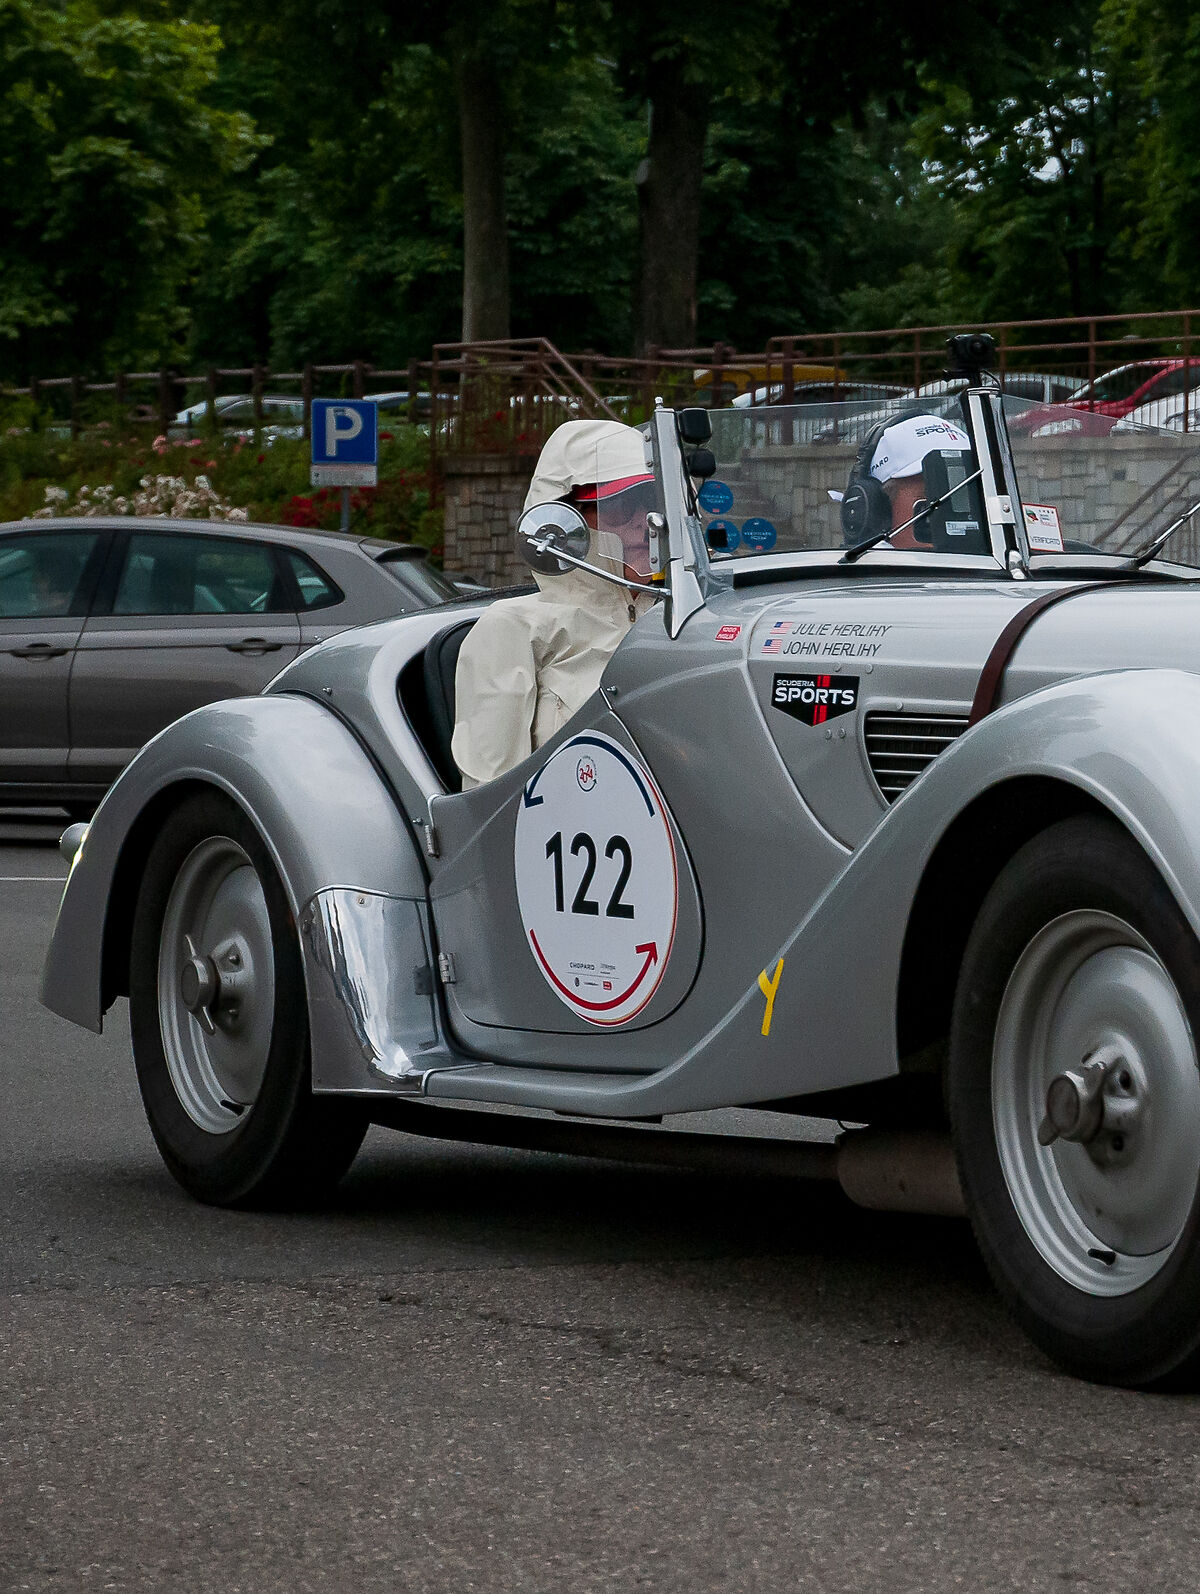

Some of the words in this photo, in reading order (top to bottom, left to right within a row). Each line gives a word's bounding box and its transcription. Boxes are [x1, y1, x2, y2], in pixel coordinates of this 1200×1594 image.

[326, 406, 363, 457] P
[871, 456, 889, 472] PARD
[792, 623, 831, 636] JULIE
[830, 624, 893, 637] HERLIHY
[782, 641, 821, 655] JOHN
[821, 642, 882, 657] HERLIHY
[776, 679, 815, 687] SCUDERIA
[774, 686, 855, 705] SPORTS
[545, 831, 635, 919] 122
[569, 961, 595, 971] CHOPARD
